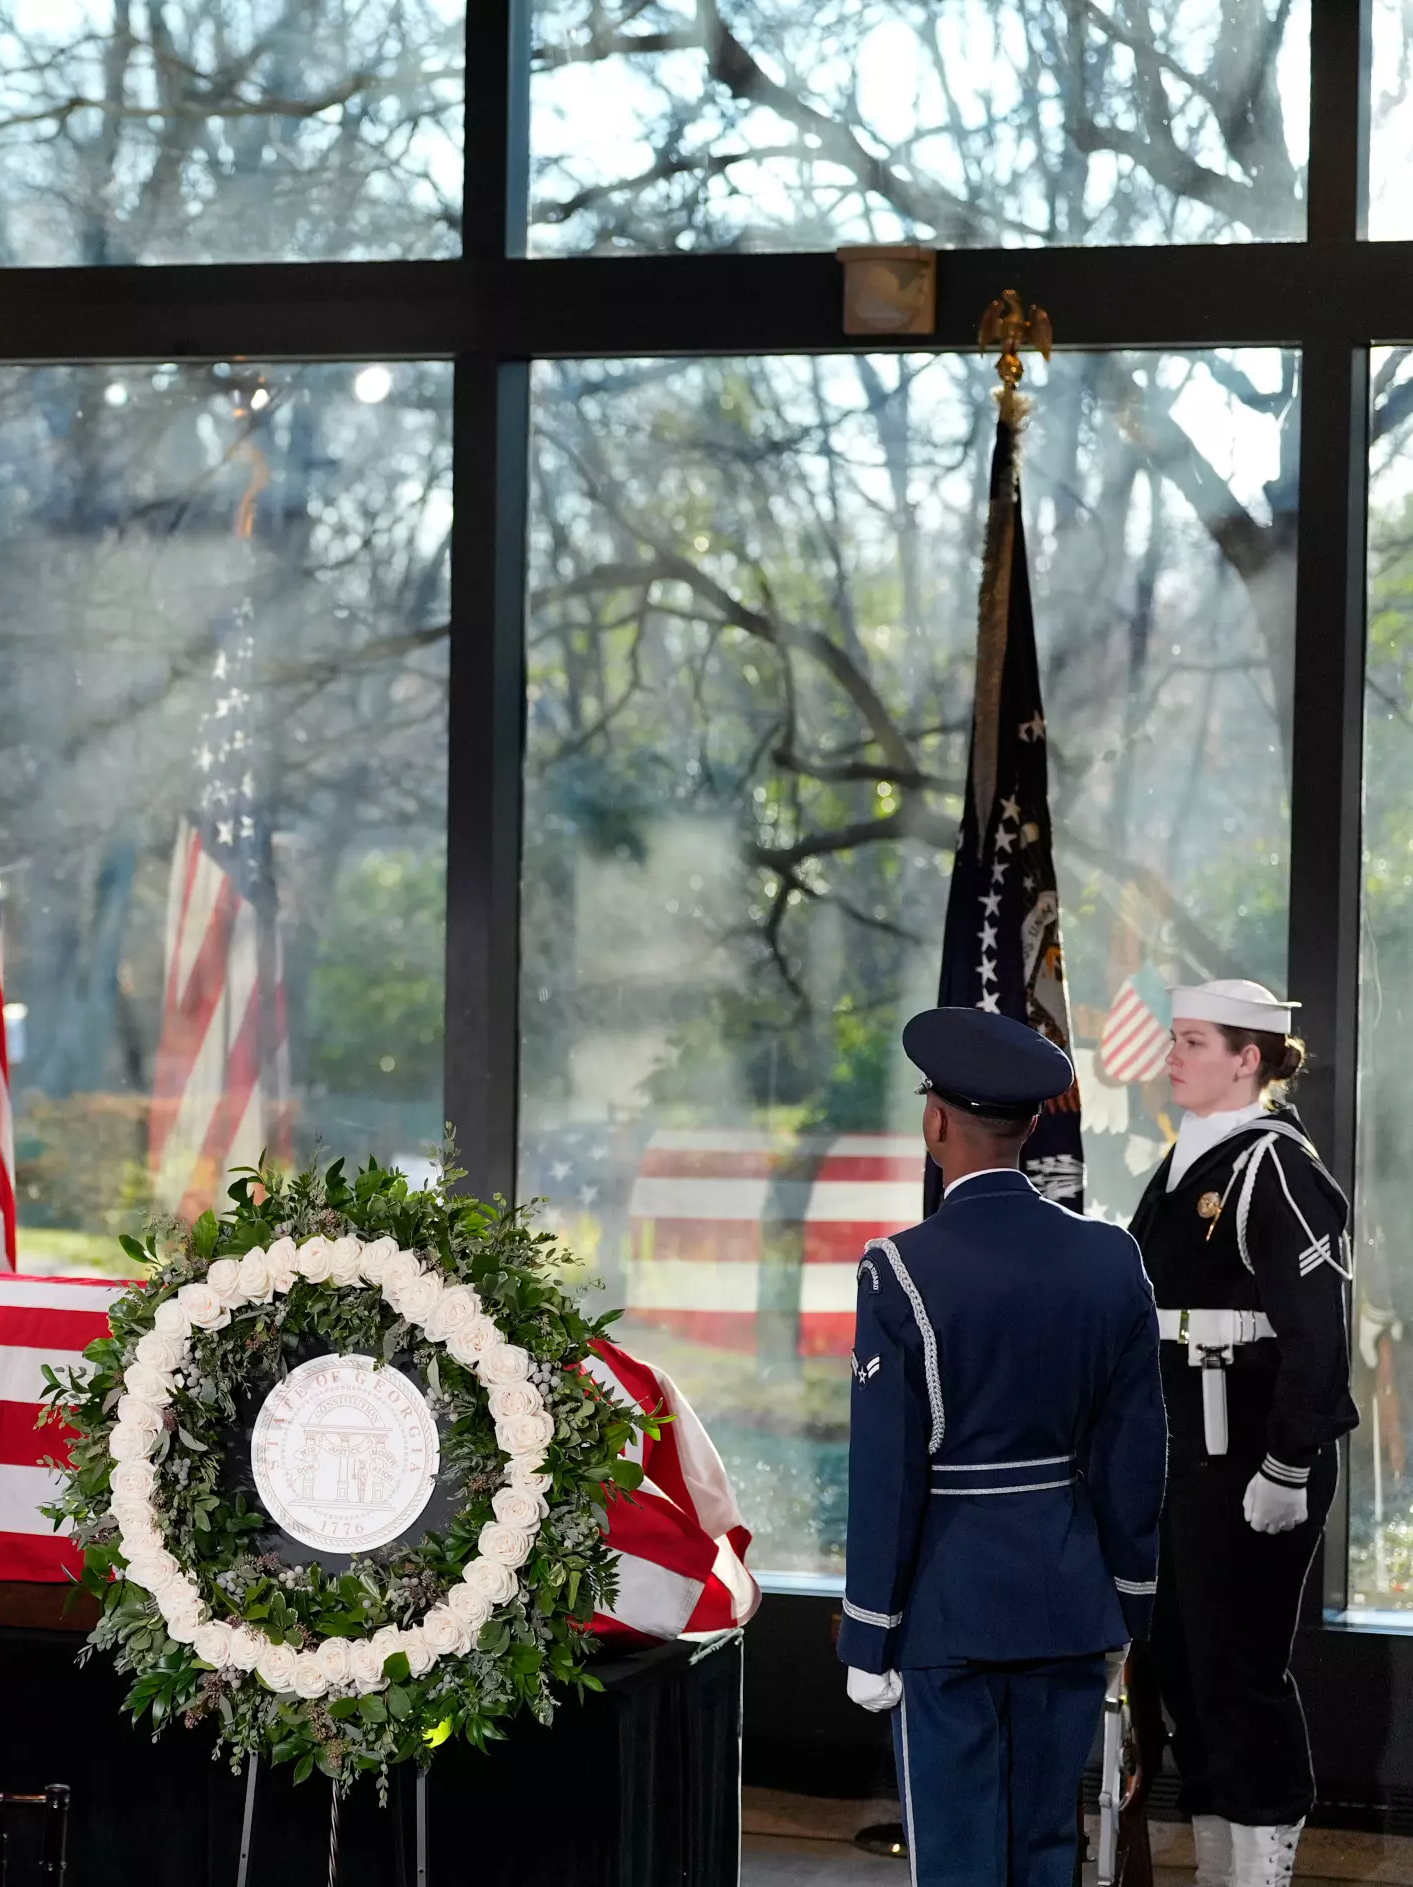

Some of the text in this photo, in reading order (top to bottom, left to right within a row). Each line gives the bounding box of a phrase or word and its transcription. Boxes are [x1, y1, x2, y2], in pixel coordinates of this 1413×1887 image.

[267, 1371, 423, 1473] STATE OF GEORGIA
[299, 1445, 316, 1456] WIS
[329, 1445, 362, 1456] JUSTICE
[297, 1463, 315, 1474] DOM
[320, 1520, 364, 1535] 1776
